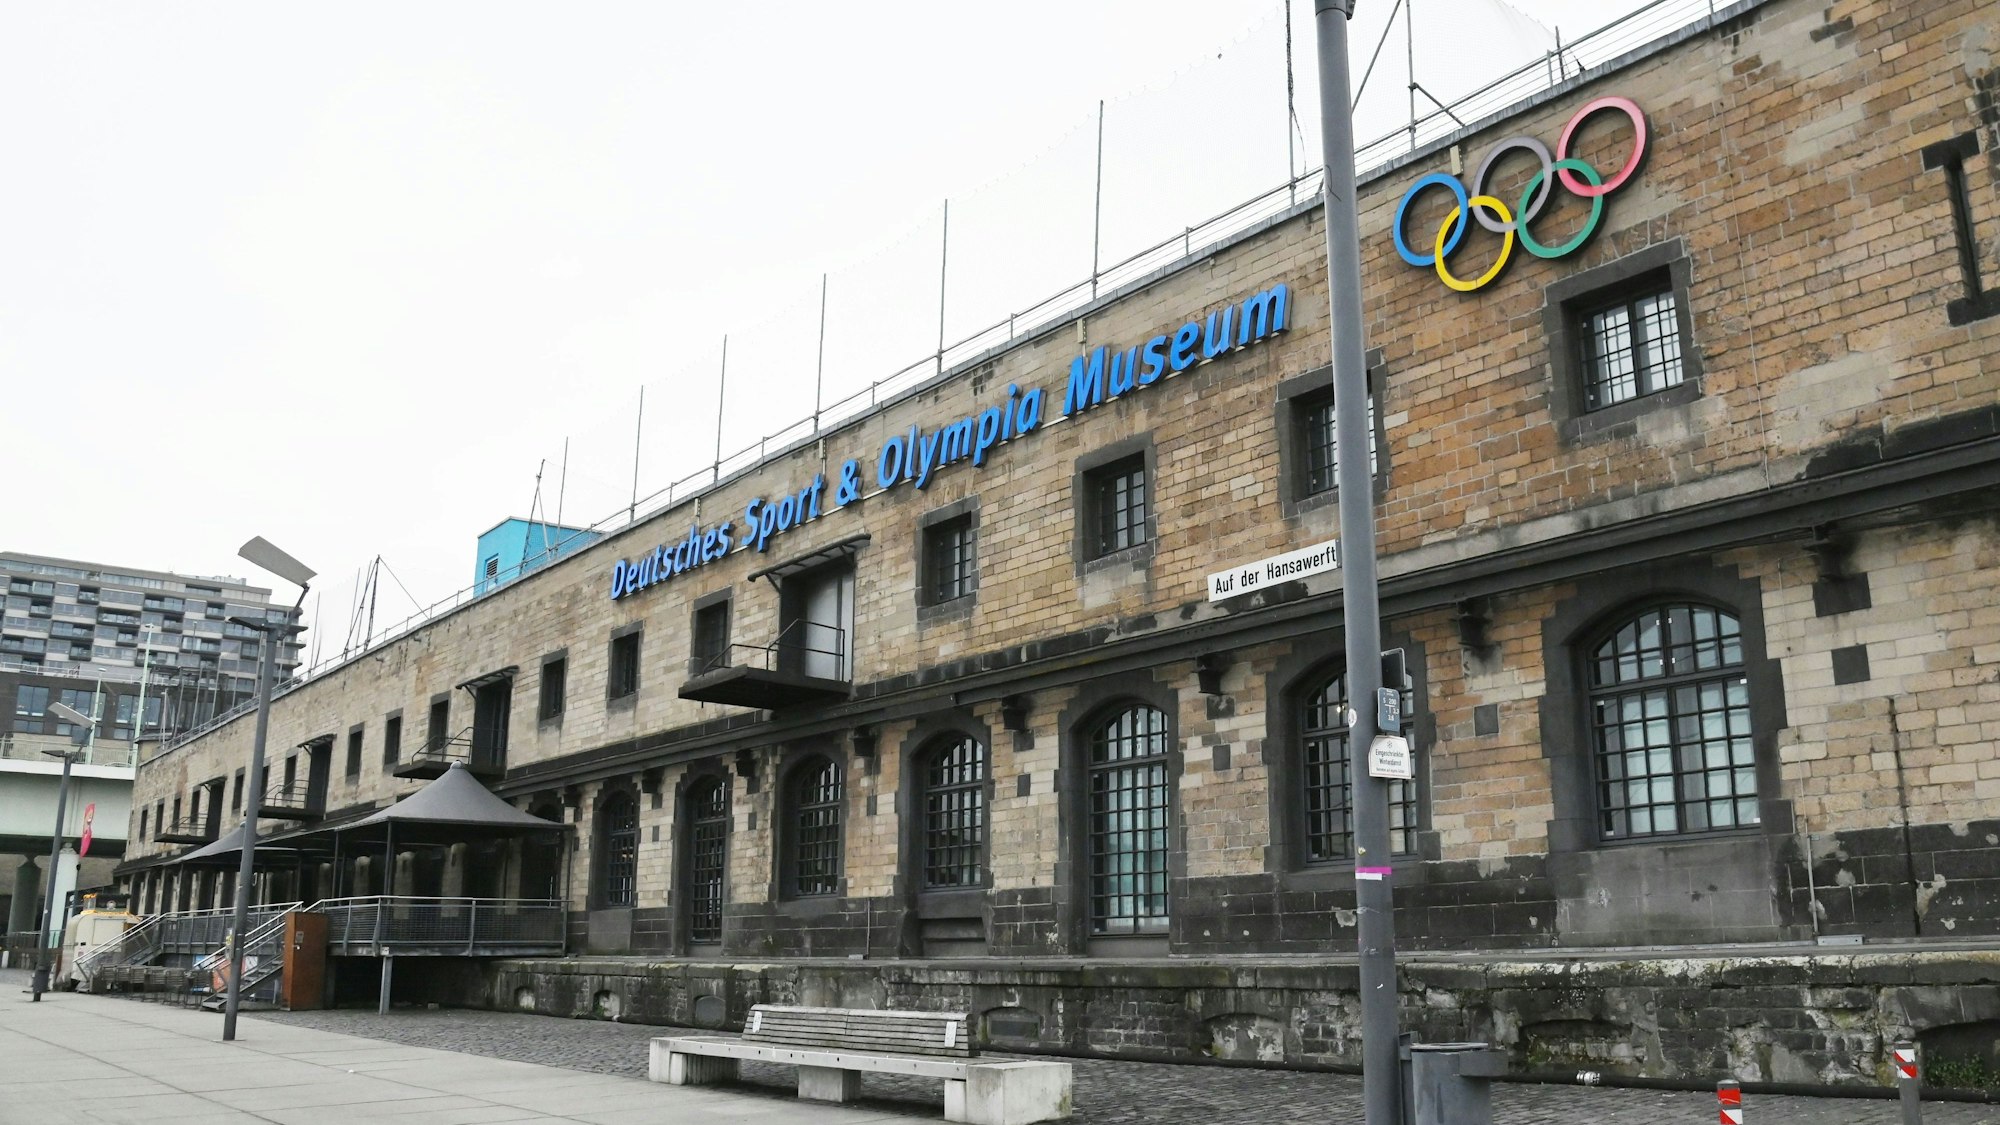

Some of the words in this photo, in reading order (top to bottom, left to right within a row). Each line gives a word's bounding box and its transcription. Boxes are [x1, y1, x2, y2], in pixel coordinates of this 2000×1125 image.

[611, 521, 732, 600] Deutsches
[741, 473, 824, 552] Sport
[835, 459, 861, 507] &
[878, 383, 1044, 489] Olympia
[1063, 282, 1289, 417] Museum
[1215, 574, 1234, 594] Auf
[1241, 570, 1260, 587] der
[1267, 546, 1337, 580] Hansawerft
